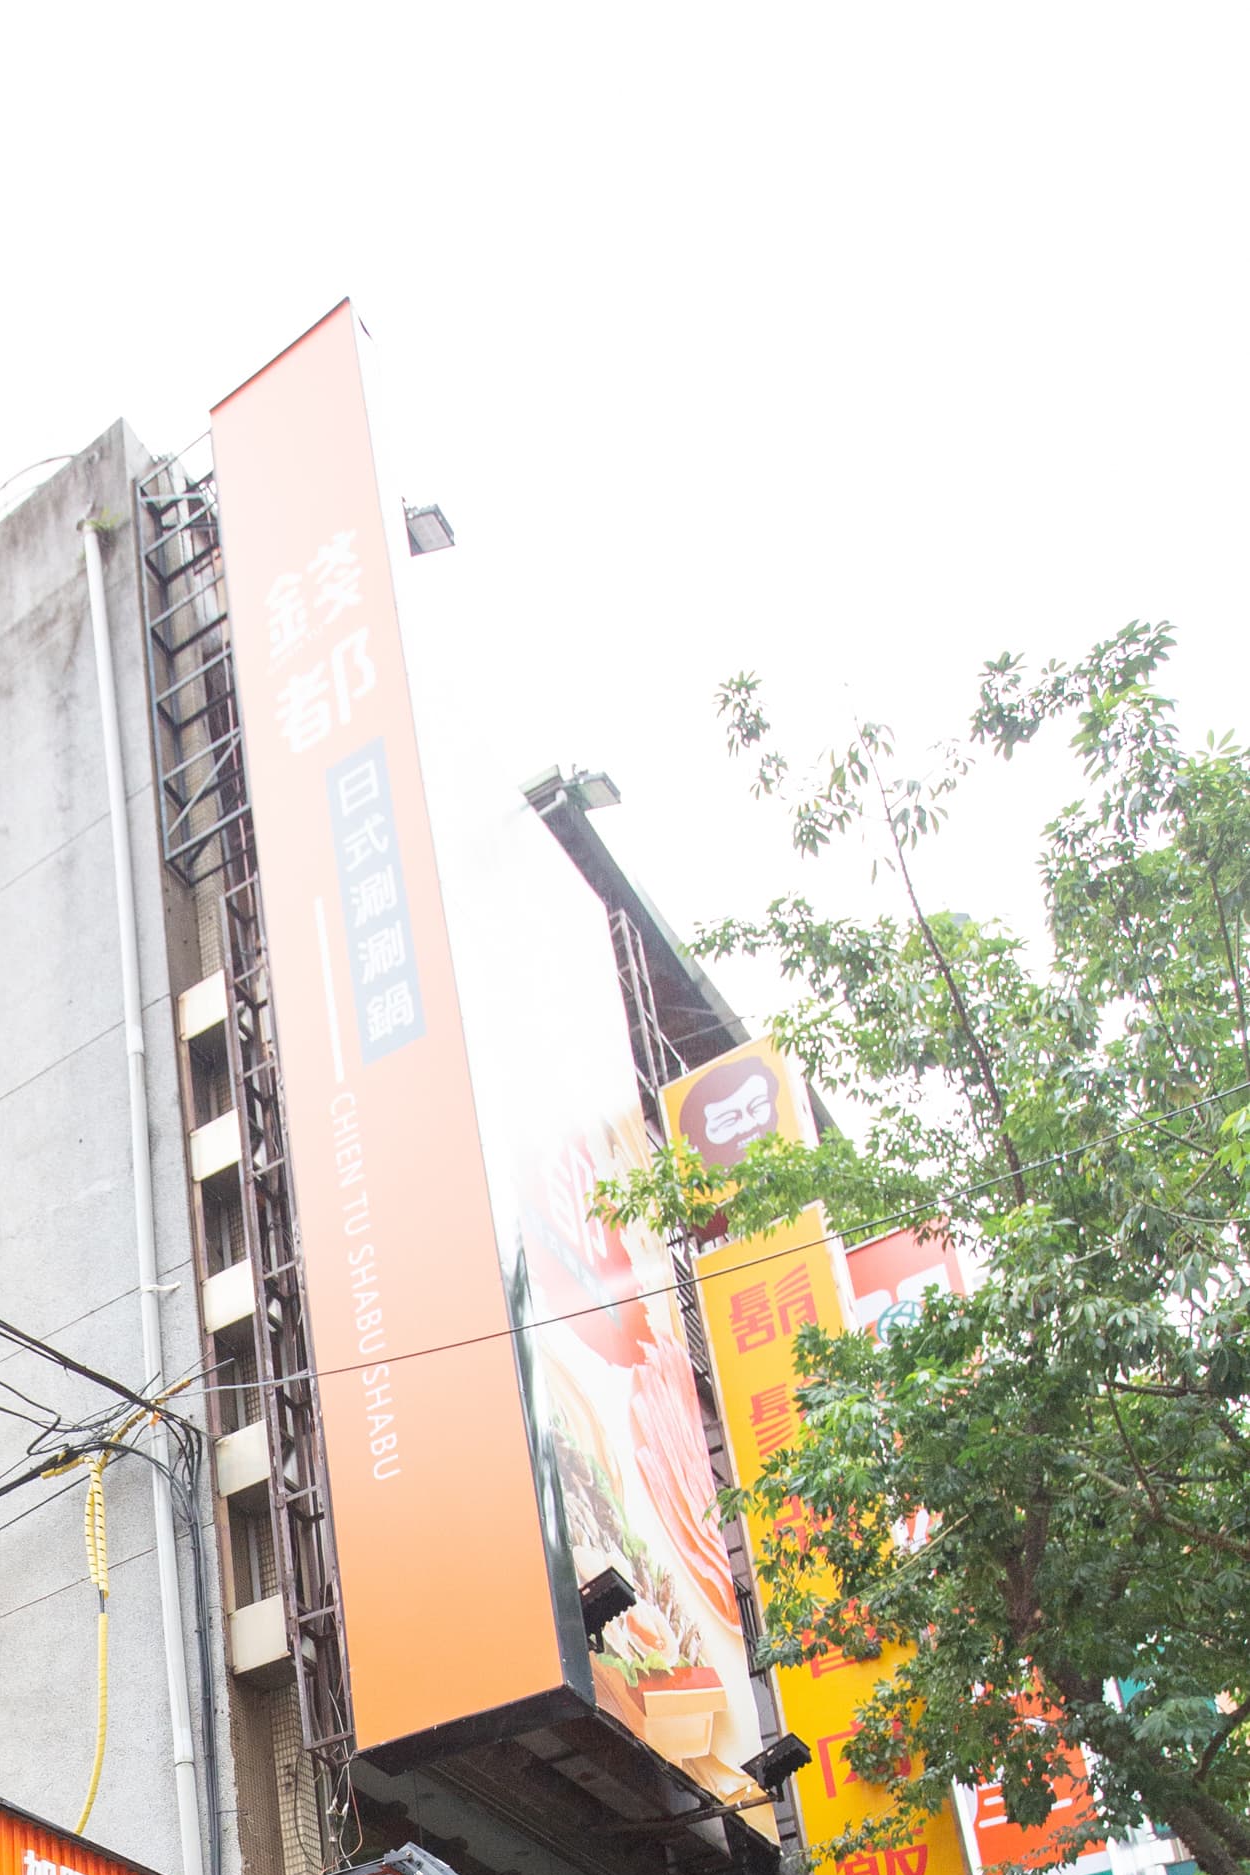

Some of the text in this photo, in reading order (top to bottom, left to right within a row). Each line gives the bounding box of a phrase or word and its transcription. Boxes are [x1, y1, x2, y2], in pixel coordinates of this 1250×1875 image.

[264, 528, 376, 754] 錢都
[337, 757, 415, 1043] 日式涮涮鍋
[331, 1093, 401, 1481] CHIEN TU SHABU SHABU
